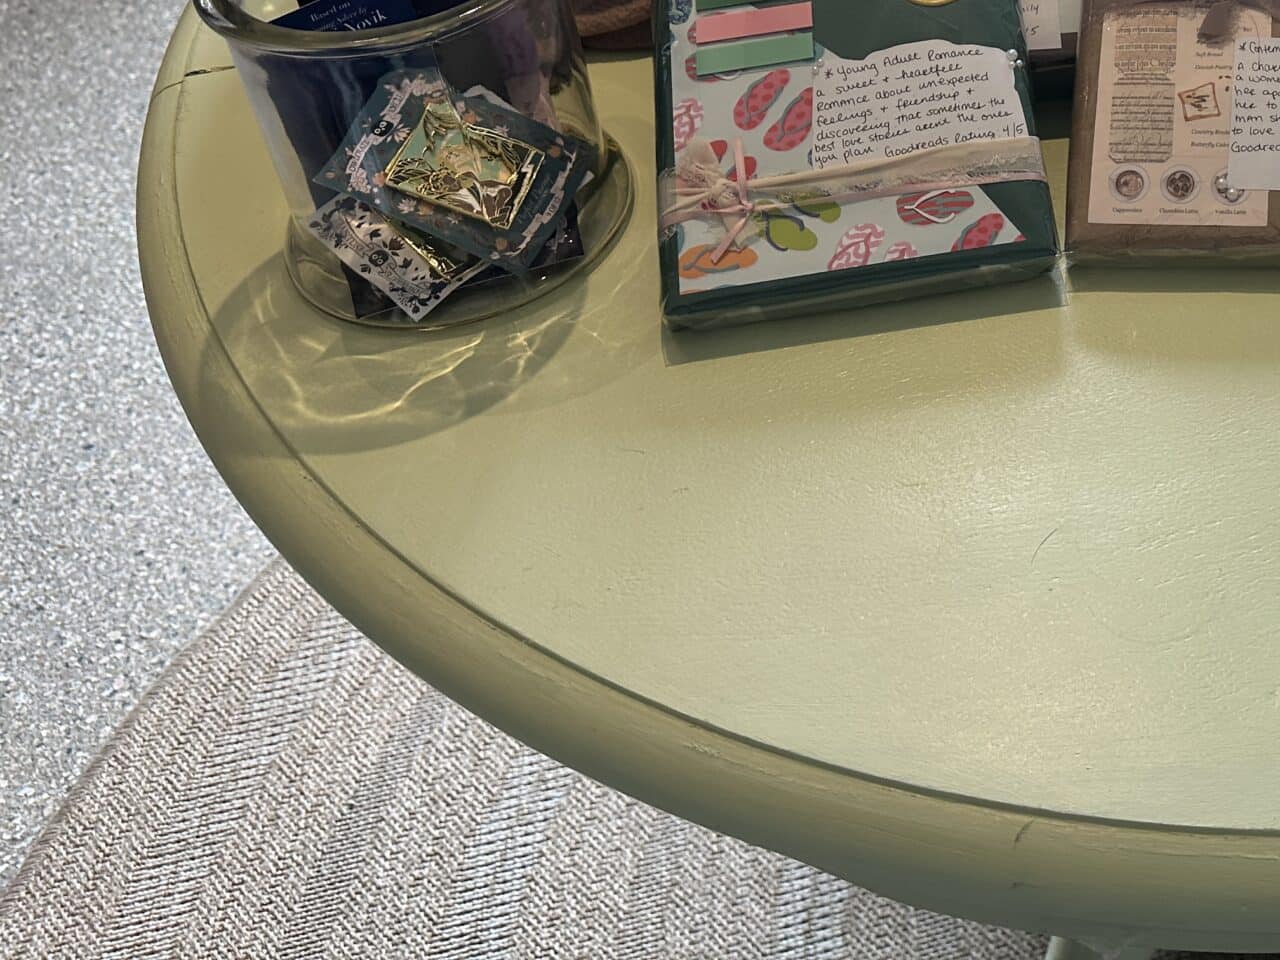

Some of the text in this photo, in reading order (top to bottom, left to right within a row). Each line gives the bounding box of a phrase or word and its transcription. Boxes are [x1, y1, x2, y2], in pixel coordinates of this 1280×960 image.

[883, 51, 921, 67] Adult
[928, 48, 984, 62] Romance
[1237, 62, 1245, 71] A
[875, 84, 911, 100] about
[918, 72, 989, 90] unexpected
[1235, 74, 1244, 82] a
[816, 89, 825, 98] a
[835, 78, 878, 95] sweet
[1234, 85, 1257, 96] her
[1235, 98, 1256, 109] her
[816, 108, 873, 127] feelings
[816, 96, 1005, 141] discovering that sometimes the
[814, 137, 836, 153] best
[841, 134, 865, 149] love
[868, 127, 910, 143] stories
[956, 111, 978, 123] the
[981, 110, 1015, 120] ones
[1232, 126, 1275, 136] to love
[814, 151, 838, 169] you
[885, 135, 949, 158] Goodreads
[954, 128, 996, 145] Rating
[1003, 123, 1025, 139] 4/5
